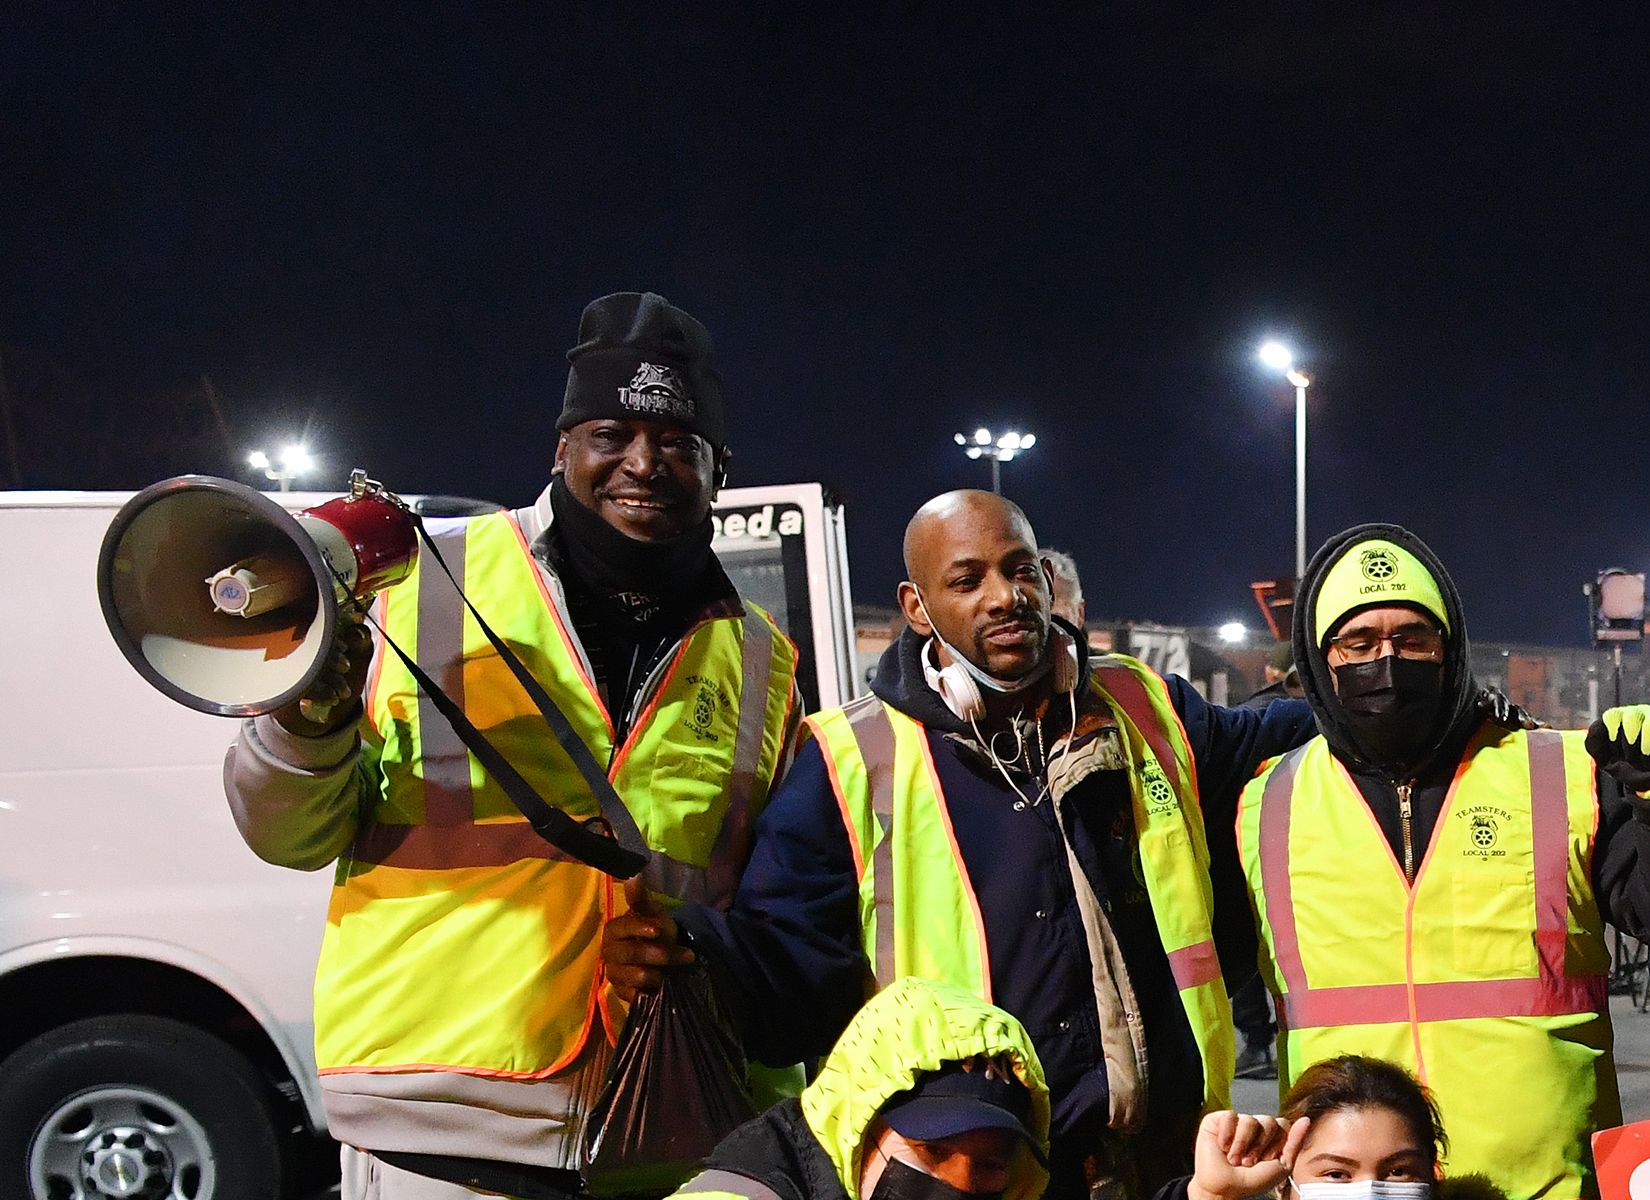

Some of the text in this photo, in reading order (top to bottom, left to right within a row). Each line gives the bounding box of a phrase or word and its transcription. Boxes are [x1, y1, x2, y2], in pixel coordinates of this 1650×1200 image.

[778, 509, 802, 536] a
[1360, 583, 1407, 595] LOCAL 202
[1146, 805, 1172, 816] LOCAL
[1455, 805, 1513, 822] TEAMSTERS
